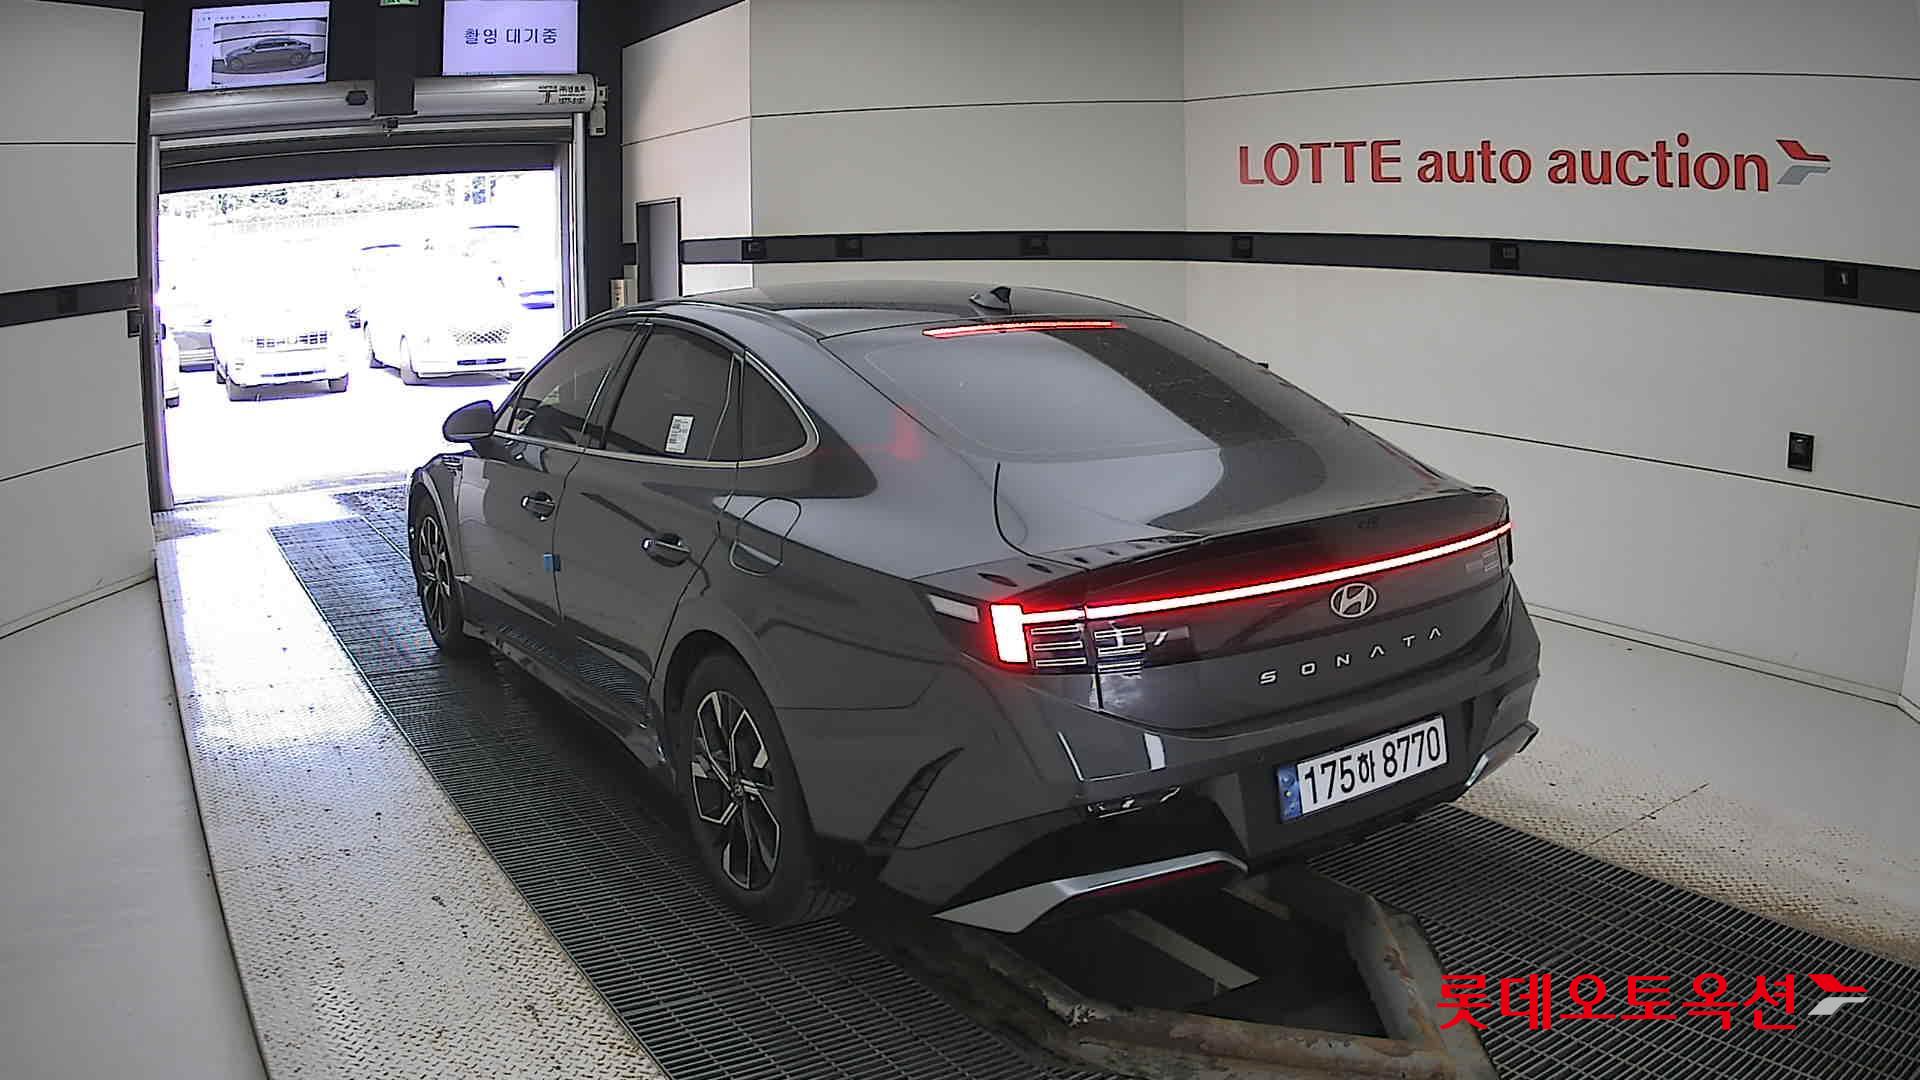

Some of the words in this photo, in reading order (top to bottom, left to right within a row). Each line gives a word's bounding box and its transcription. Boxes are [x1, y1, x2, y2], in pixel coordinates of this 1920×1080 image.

[506, 28, 557, 45] 대기중
[1239, 140, 1401, 185] LOTTE
[1417, 140, 1531, 184] auto
[1547, 133, 1769, 192] auction
[1259, 628, 1441, 685] SONATA
[1304, 750, 1376, 804] 175하
[1382, 726, 1441, 778] 8770
